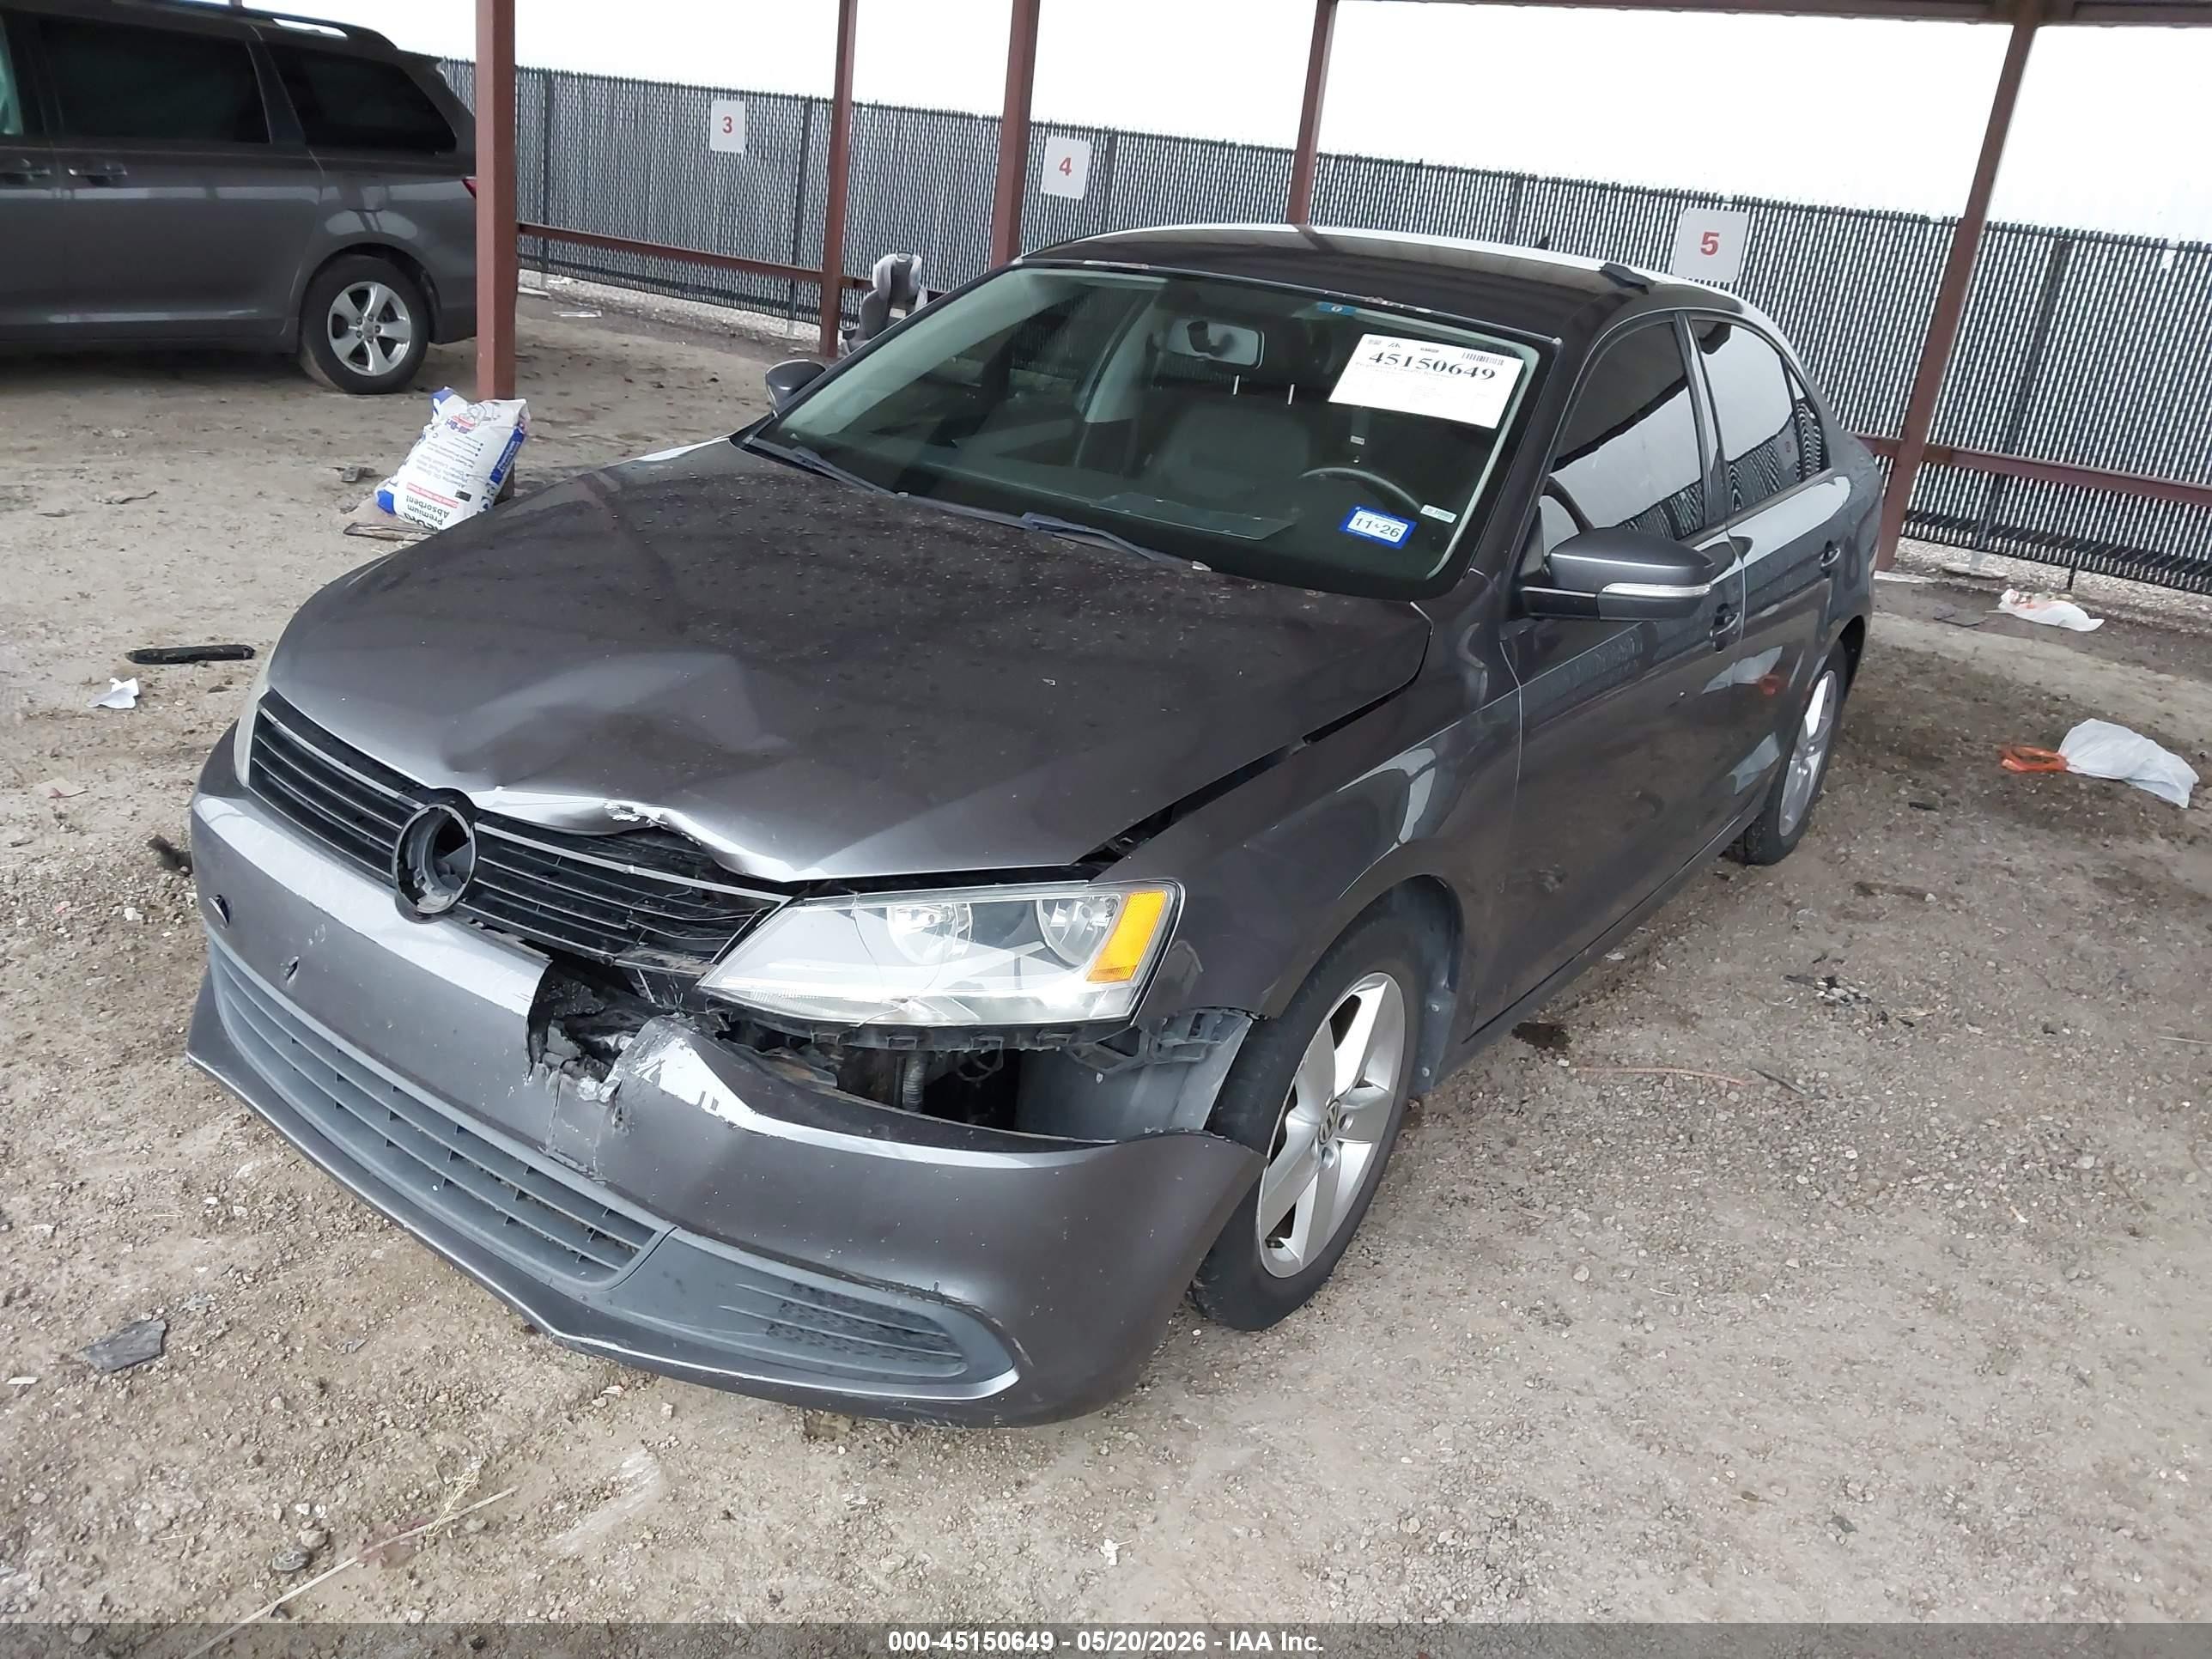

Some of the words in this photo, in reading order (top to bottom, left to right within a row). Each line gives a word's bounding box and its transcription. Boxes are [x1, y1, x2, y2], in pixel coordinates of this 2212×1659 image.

[722, 116, 732, 134] 3
[1059, 157, 1072, 176] 4
[1700, 232, 1720, 256] 5
[1369, 352, 1496, 380] 45150649
[406, 495, 450, 519] Absorbent
[407, 504, 444, 526] Premium
